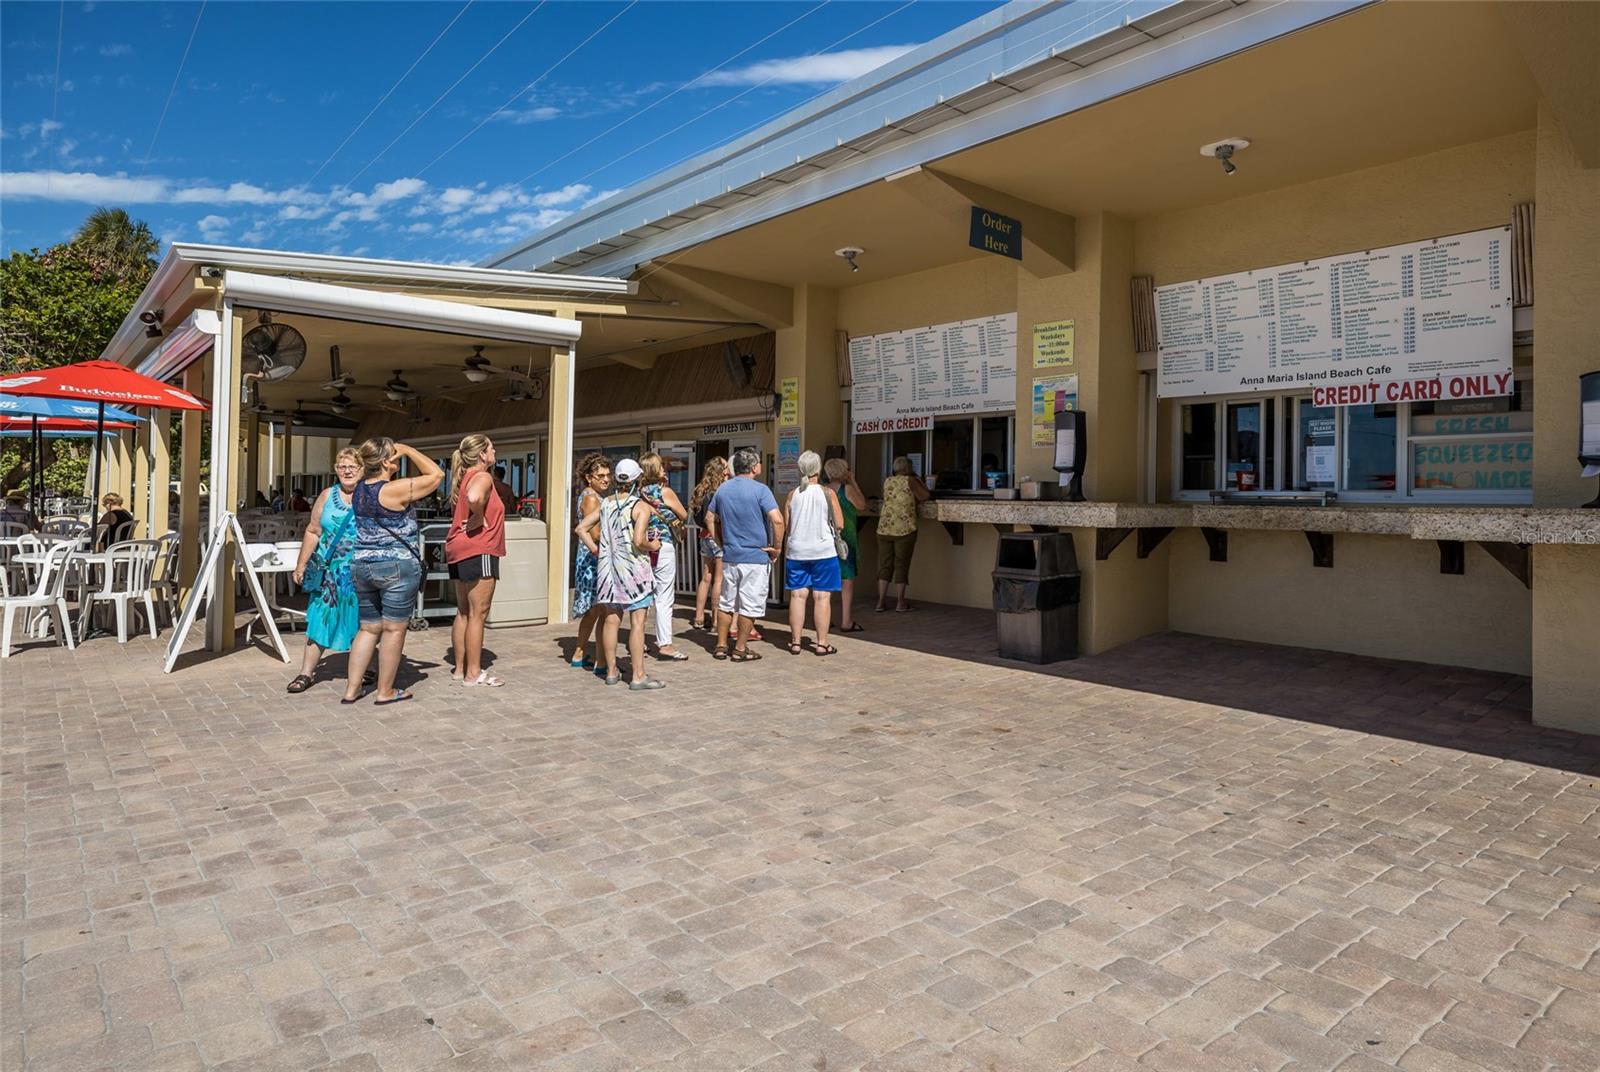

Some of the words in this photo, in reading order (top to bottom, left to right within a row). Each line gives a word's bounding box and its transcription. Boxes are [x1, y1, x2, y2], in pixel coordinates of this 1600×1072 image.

[982, 213, 1012, 234] Order
[984, 234, 1008, 254] Here
[1240, 377, 1264, 385] Anna
[1267, 374, 1293, 383] Maria
[1296, 370, 1326, 381] Island
[1330, 368, 1363, 378] Beach
[1366, 365, 1392, 375] Cafe
[58, 384, 162, 400] Budweiser
[1314, 383, 1380, 405] CREDIT
[1386, 380, 1441, 401] CARD
[1449, 373, 1510, 398] ONLY
[925, 404, 941, 412] Island
[943, 403, 960, 411] Beach
[704, 424, 738, 435] EMPLOYEES
[740, 422, 755, 432] ONLY
[856, 420, 879, 432] CASH
[882, 419, 894, 431] OR
[897, 416, 930, 430] CREDIT
[1435, 416, 1509, 433] FRESH
[1415, 442, 1532, 465] SQUEEZED
